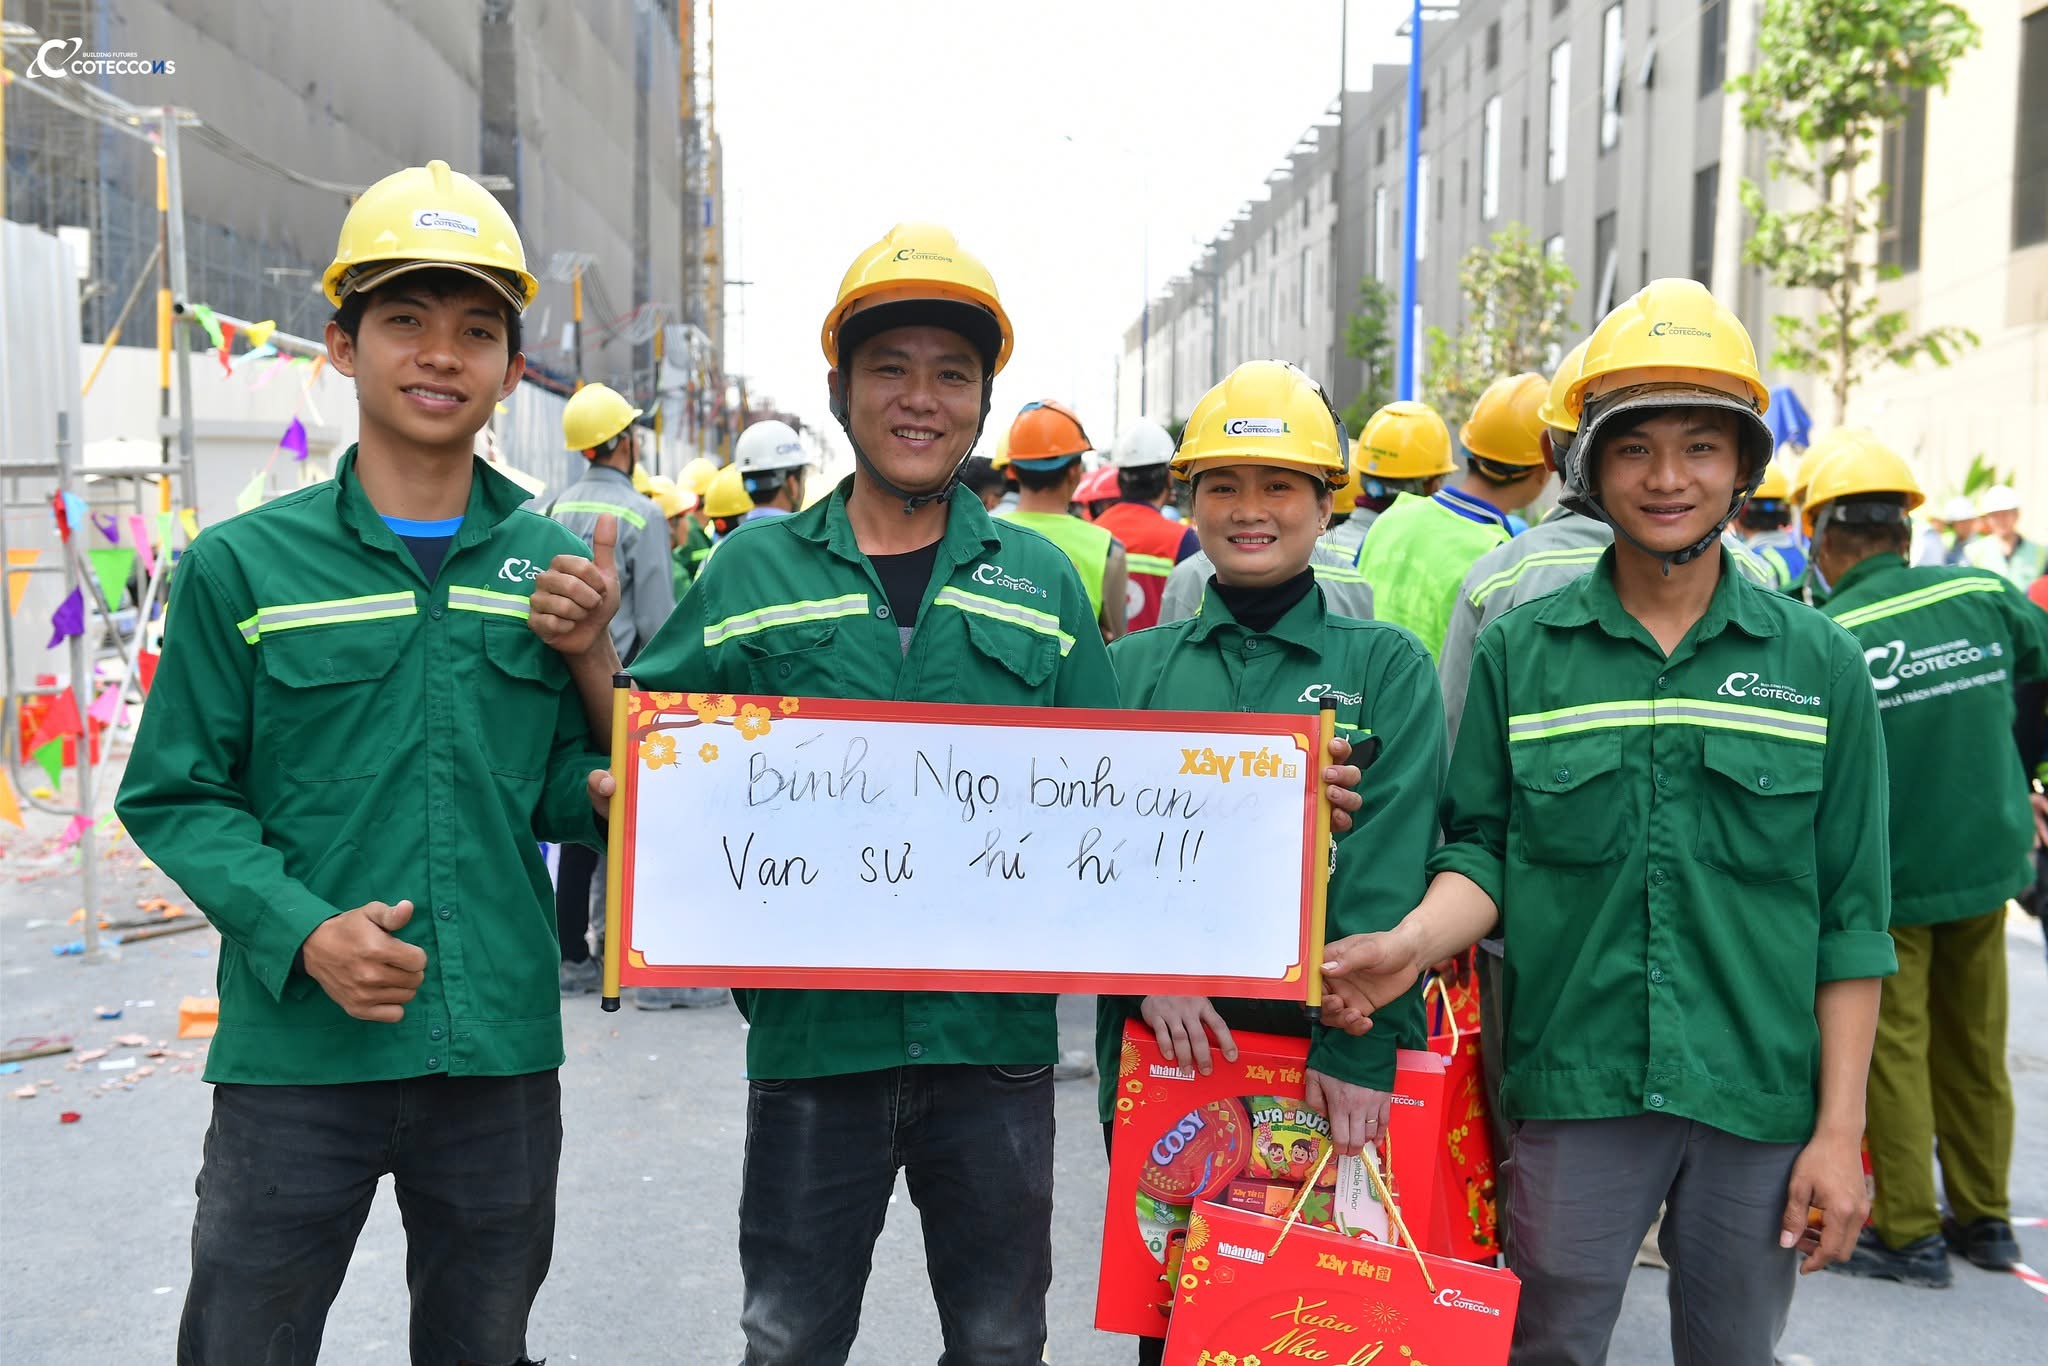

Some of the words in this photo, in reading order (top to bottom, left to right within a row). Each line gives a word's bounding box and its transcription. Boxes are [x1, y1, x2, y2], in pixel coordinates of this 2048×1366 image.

[914, 744, 999, 823] Ngọ
[1030, 756, 1126, 808] bình
[1136, 787, 1208, 820] an
[1178, 747, 1236, 784] Xây
[1239, 746, 1283, 778] Tết
[722, 832, 819, 904] Vạn
[860, 842, 913, 897] sự
[969, 827, 1033, 880] hí
[1067, 827, 1127, 884] hí
[1245, 1064, 1275, 1085] Xây
[1279, 1066, 1302, 1084] Tết
[1150, 1108, 1207, 1167] COSY
[1350, 1187, 1361, 1211] Flavor
[1314, 1252, 1348, 1276] Xây
[1351, 1259, 1376, 1279] Tết
[1270, 1295, 1359, 1333] Xuân
